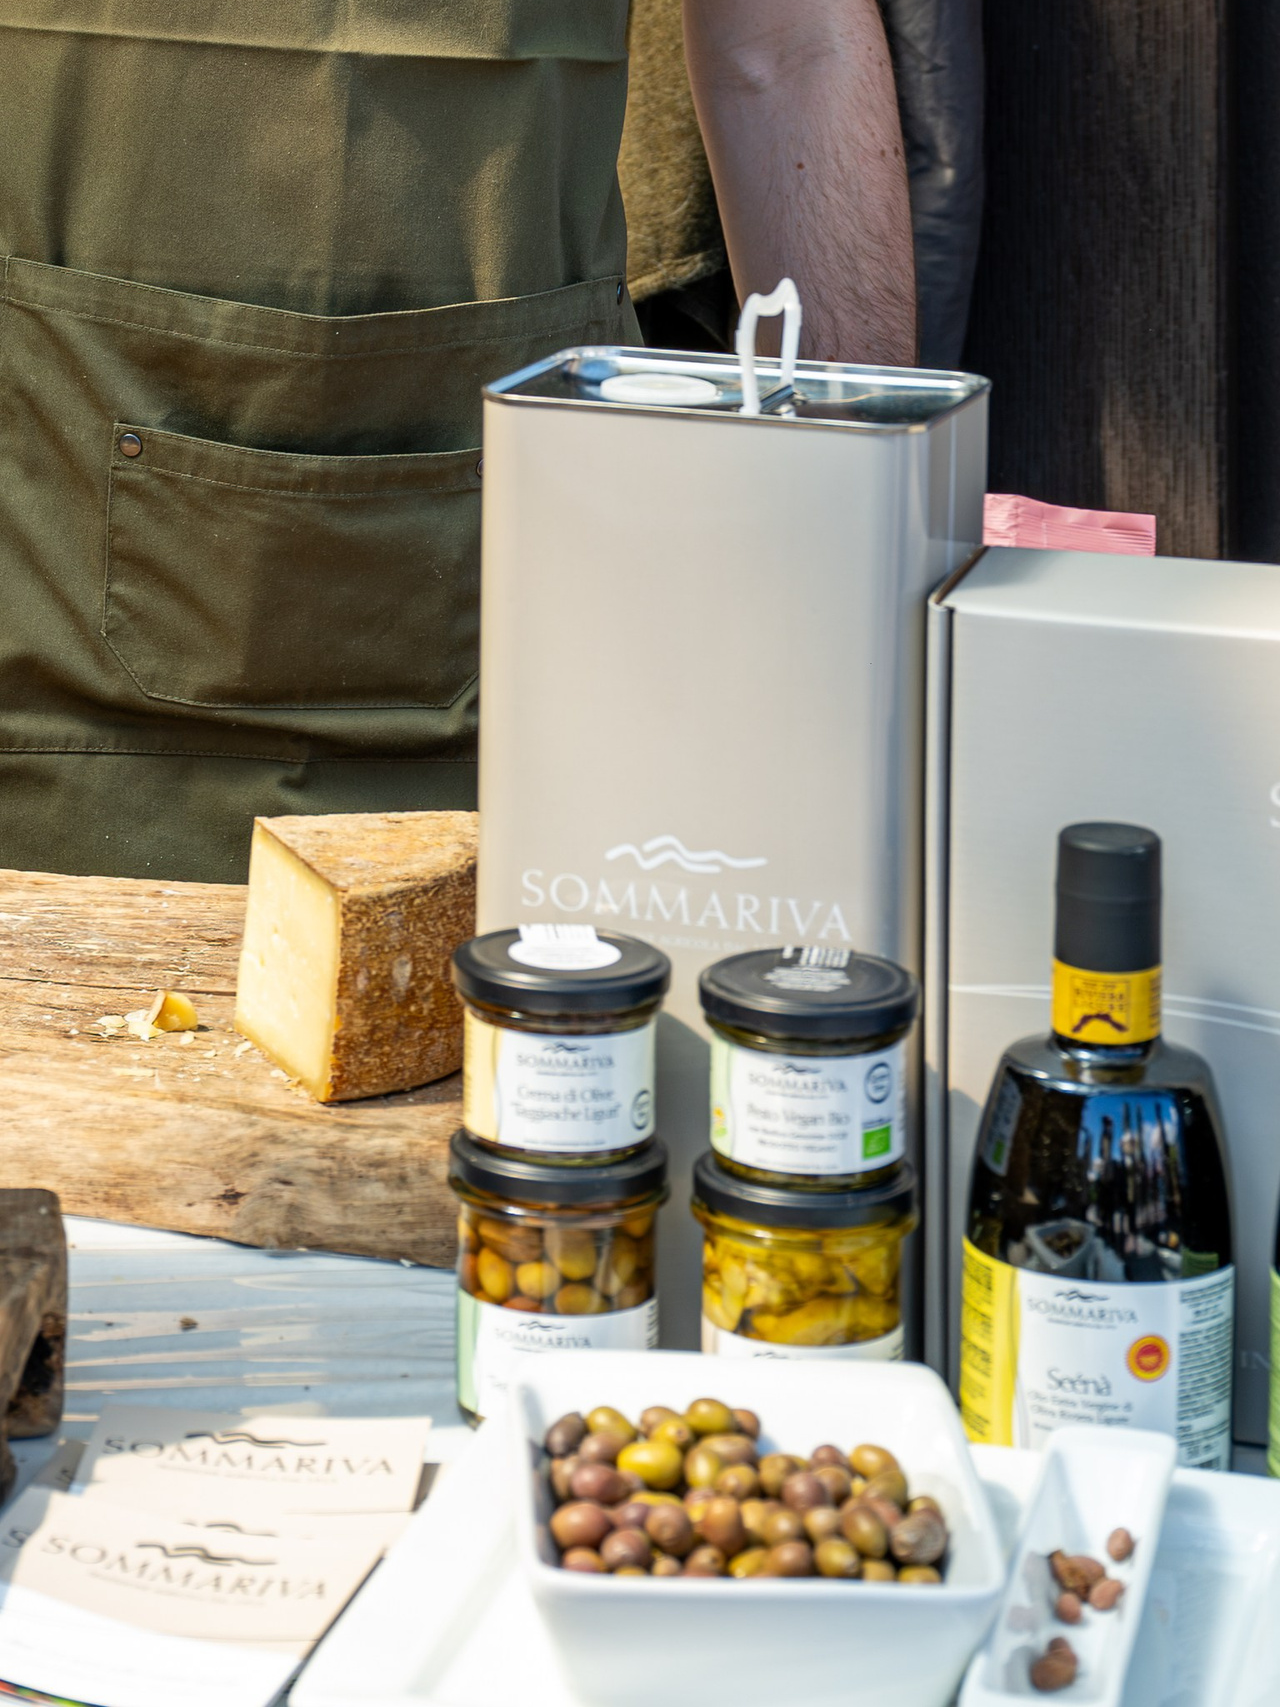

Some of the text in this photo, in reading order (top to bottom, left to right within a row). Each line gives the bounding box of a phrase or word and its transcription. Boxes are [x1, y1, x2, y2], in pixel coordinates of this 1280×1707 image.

[520, 868, 854, 943] SOMMARIVA
[516, 1052, 615, 1070] SOMMARIVA
[748, 1072, 849, 1093] SOMMARIVA
[1027, 1298, 1139, 1324] SOMMARIVA
[494, 1327, 593, 1349] SOMMARIVA
[102, 1435, 395, 1478] SOMMARIVA
[39, 1536, 328, 1601] SOMMARIVA
